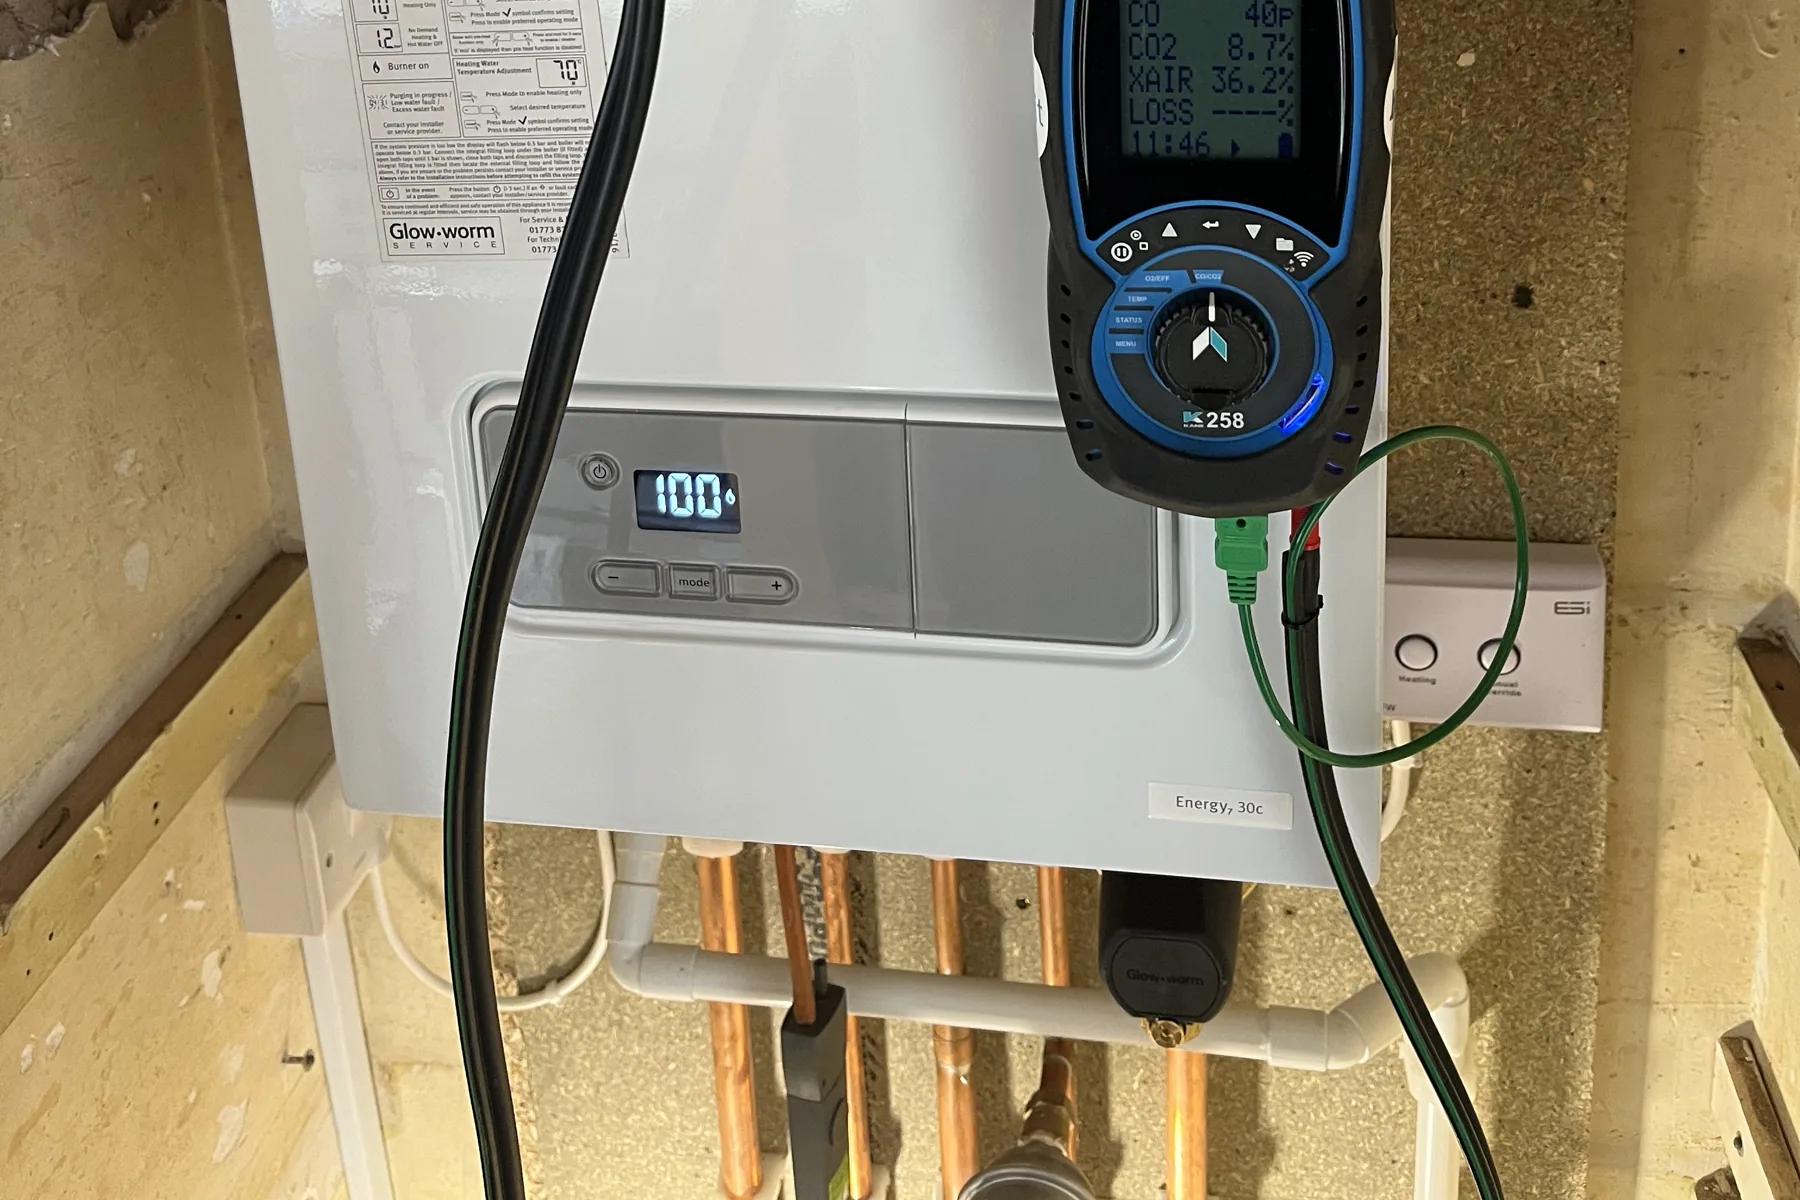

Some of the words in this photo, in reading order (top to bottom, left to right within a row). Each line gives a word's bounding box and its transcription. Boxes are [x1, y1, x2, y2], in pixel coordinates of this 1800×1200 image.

[1128, 33, 1177, 60] CO2
[1228, 33, 1294, 61] 8.7%
[388, 62, 417, 71] Burner
[1129, 66, 1194, 93] XAIR
[1212, 66, 1294, 94] 36.2%
[1130, 99, 1194, 125] LOSS
[1132, 131, 1210, 157] 11:46
[1115, 316, 1142, 324] STATUS
[1207, 411, 1245, 429] 258
[679, 577, 710, 588] mode
[1238, 801, 1264, 815] 30c
